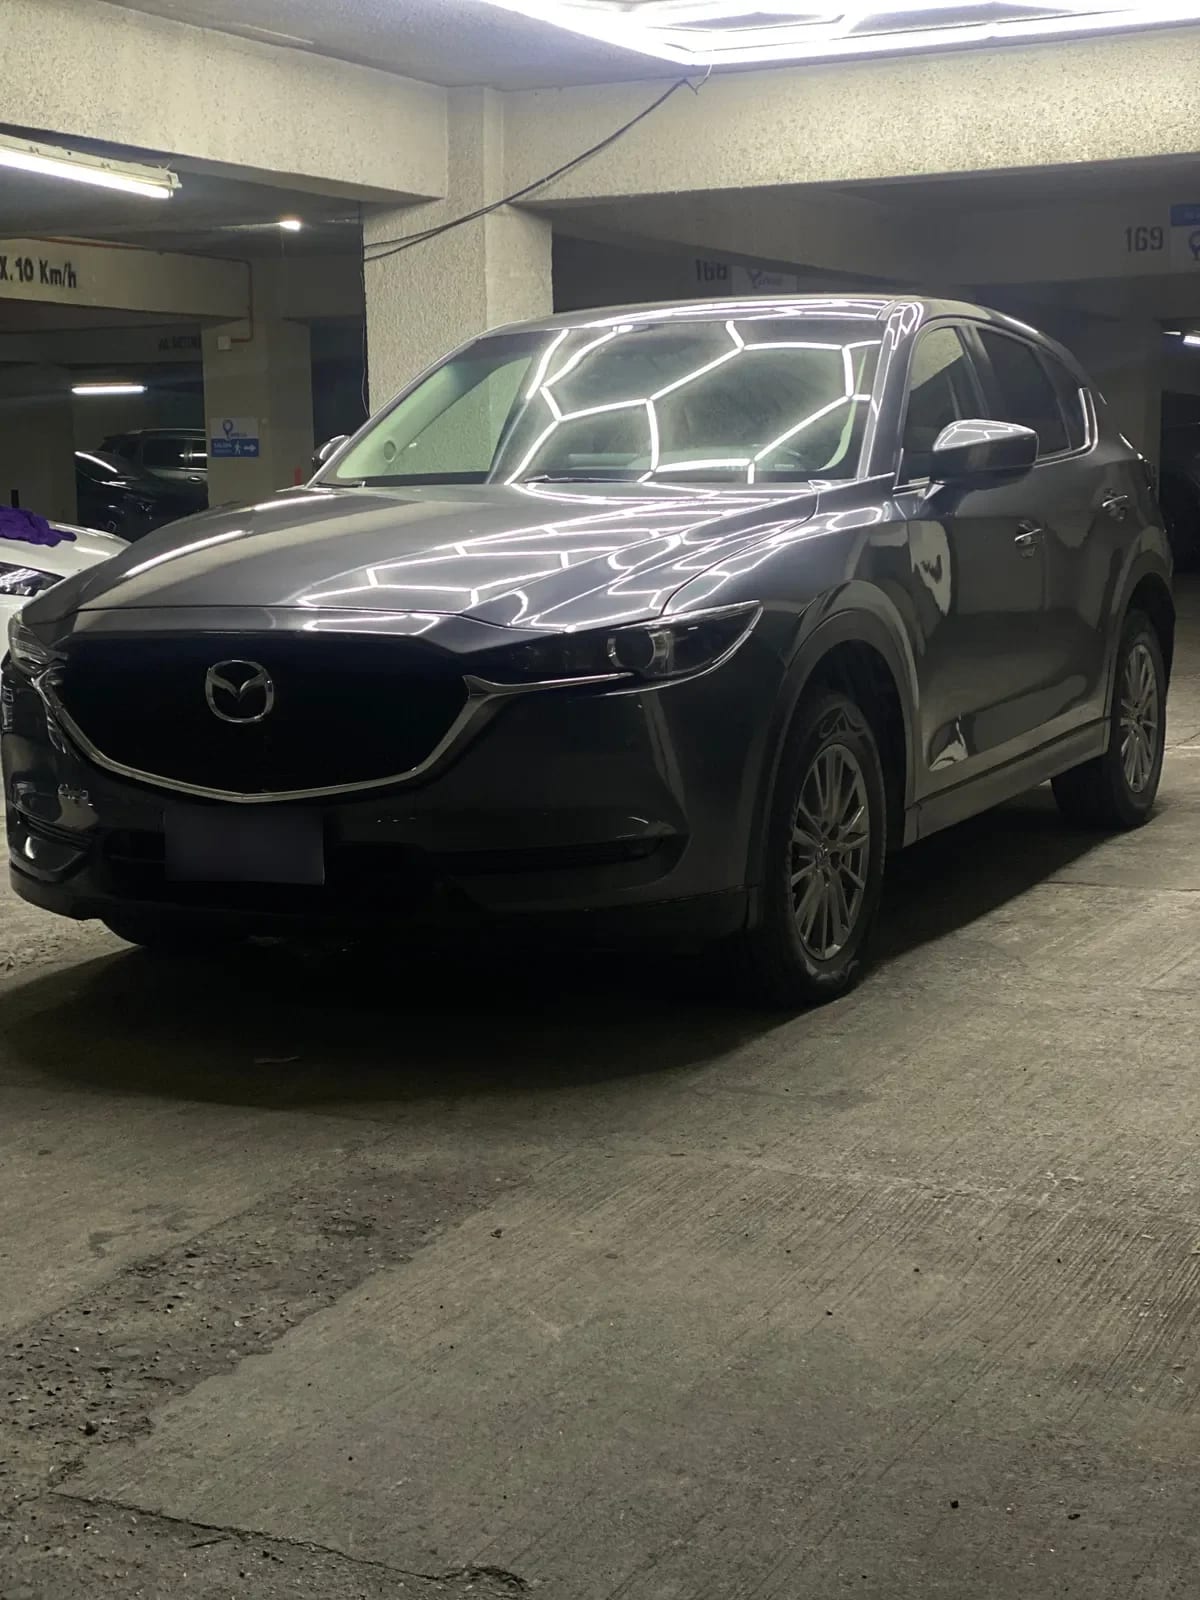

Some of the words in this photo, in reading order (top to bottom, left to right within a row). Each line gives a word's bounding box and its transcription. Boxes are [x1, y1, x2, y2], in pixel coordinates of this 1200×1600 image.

[1124, 225, 1164, 253] 169
[15, 256, 34, 283] 10
[39, 258, 77, 289] Km/h
